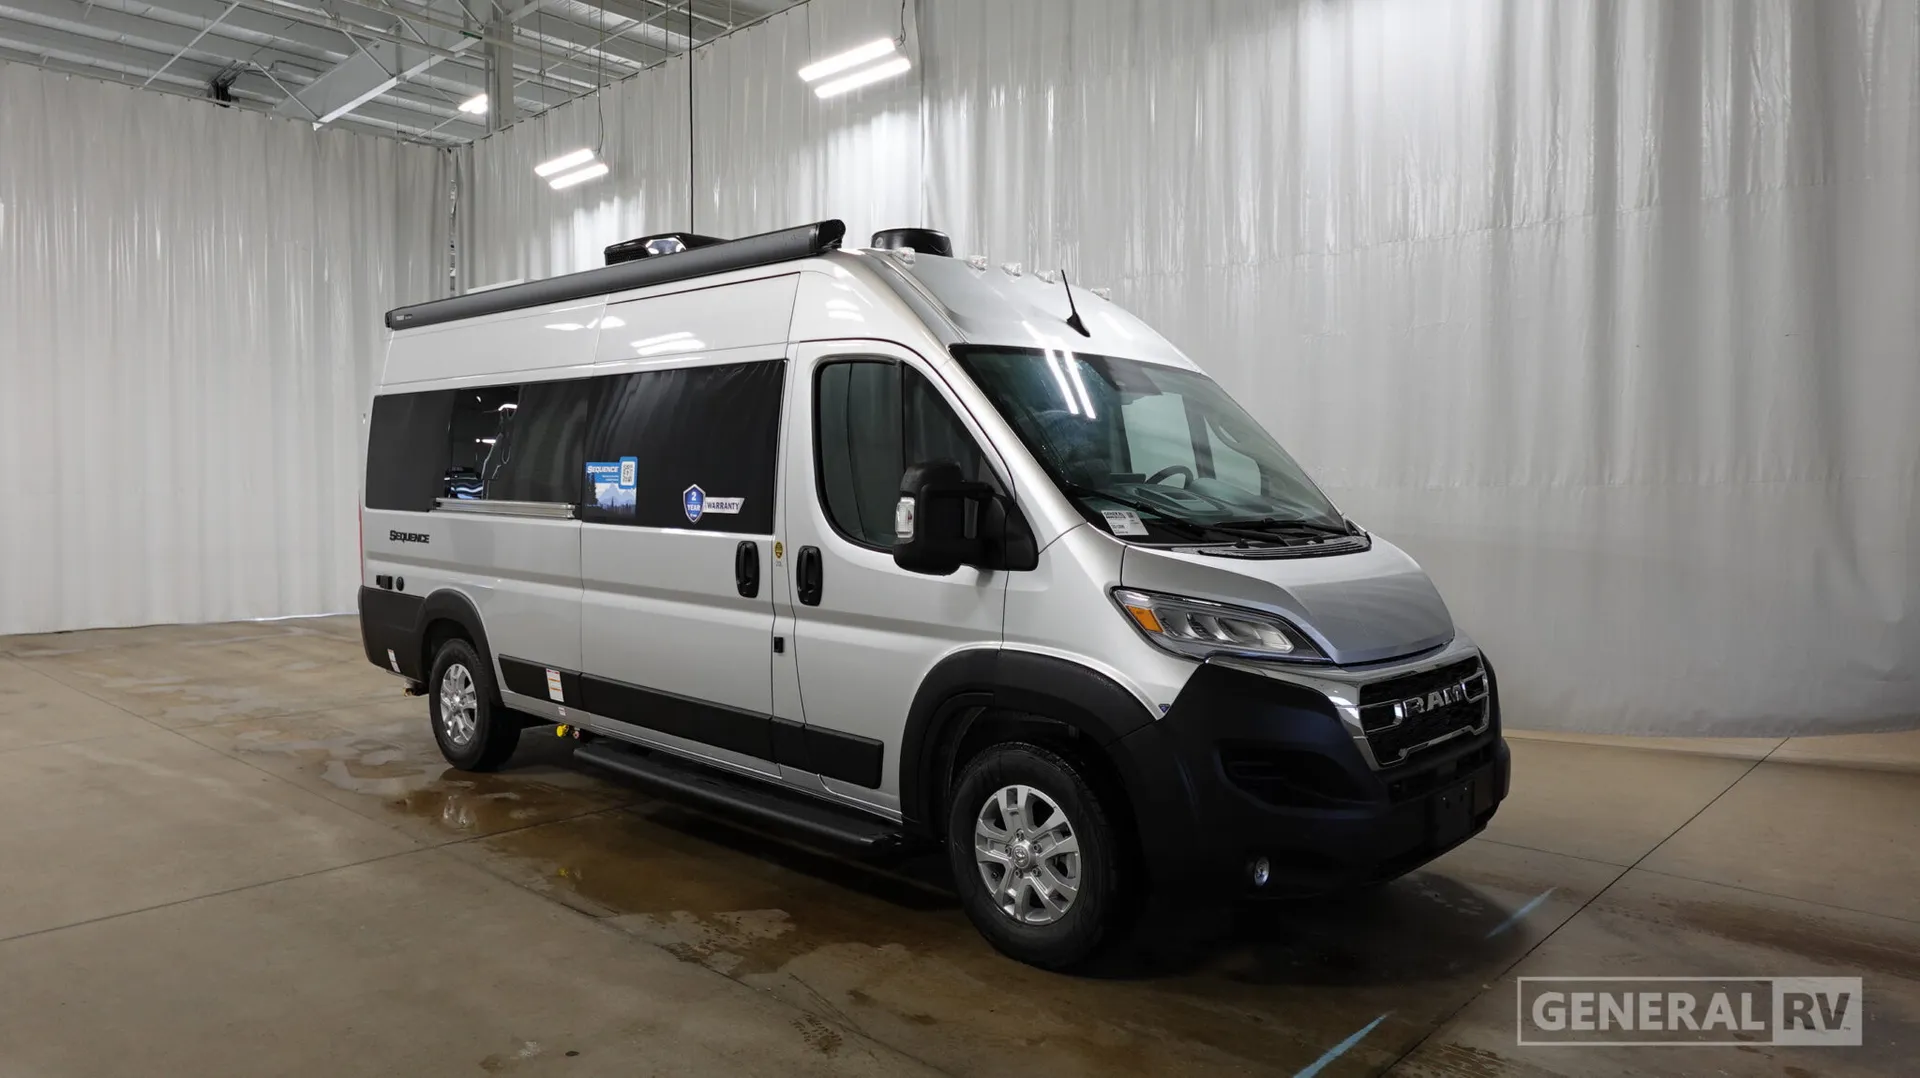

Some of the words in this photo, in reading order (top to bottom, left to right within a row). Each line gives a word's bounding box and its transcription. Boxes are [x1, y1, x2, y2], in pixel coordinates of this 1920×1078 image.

[691, 491, 697, 502] 2
[706, 501, 740, 510] WARRANTY
[1403, 684, 1462, 718] RAM
